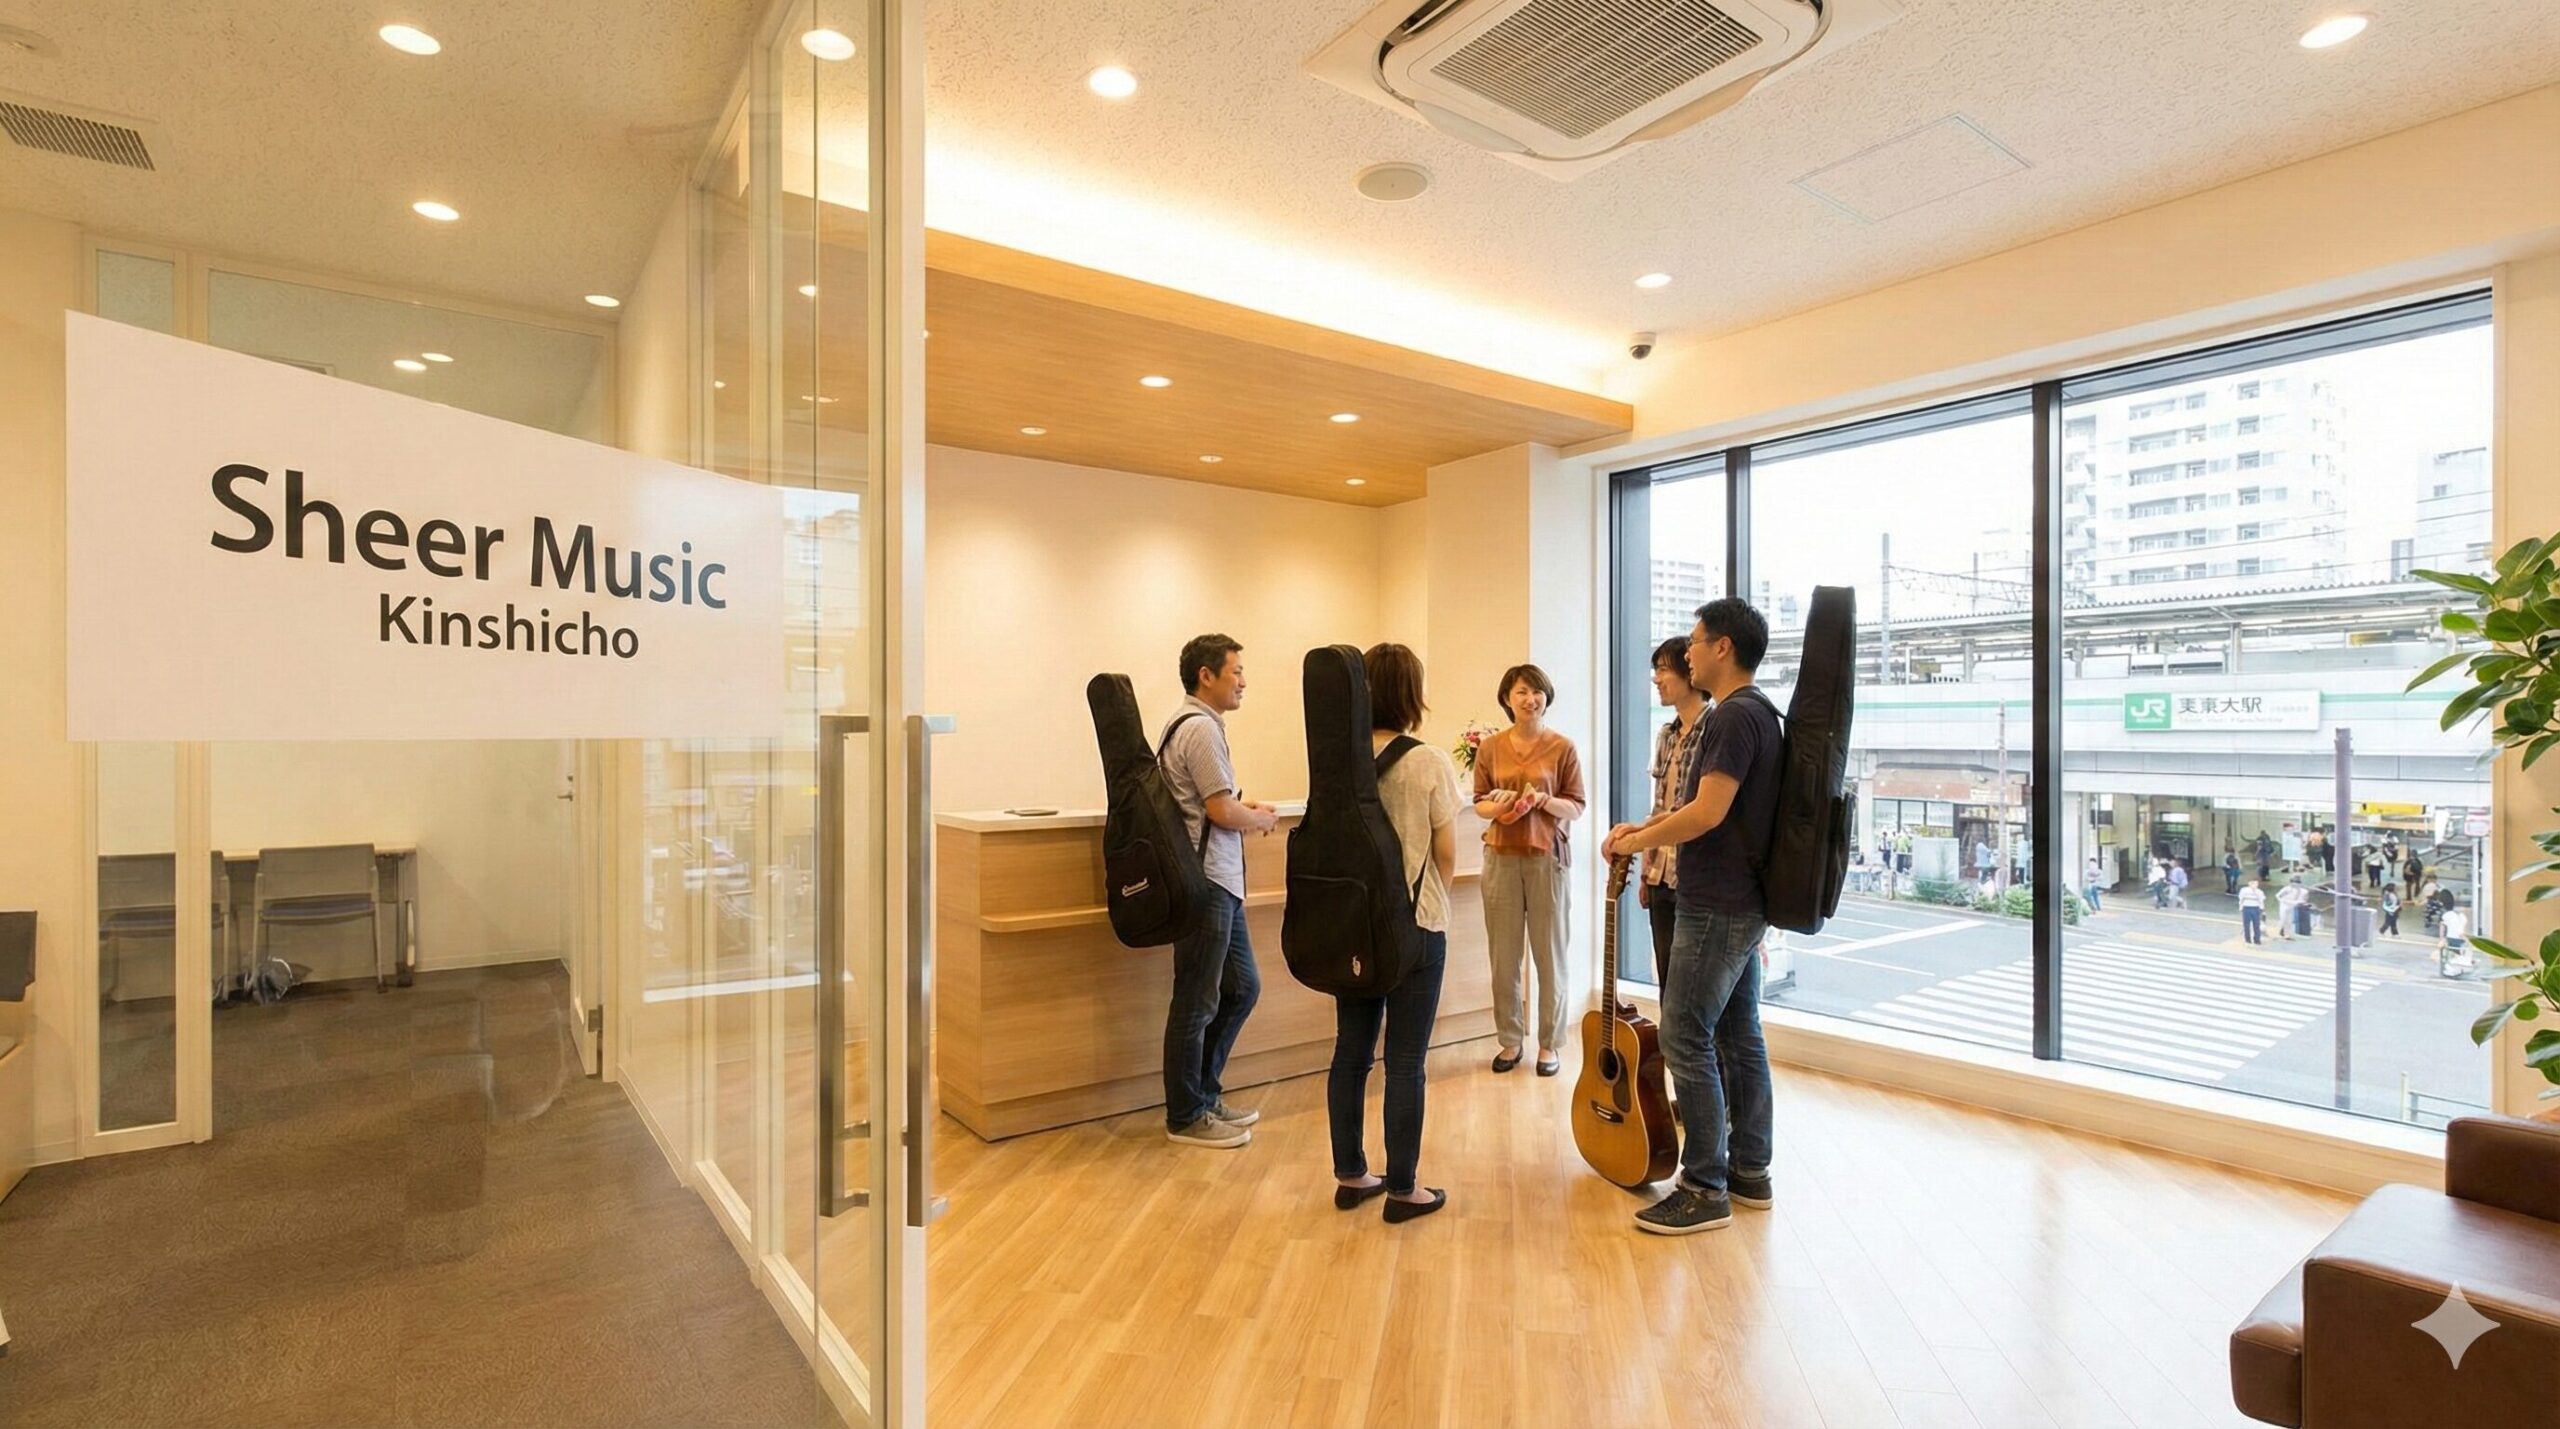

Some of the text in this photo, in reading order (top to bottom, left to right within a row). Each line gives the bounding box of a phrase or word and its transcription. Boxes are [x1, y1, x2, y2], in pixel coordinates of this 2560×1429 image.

[210, 463, 727, 610] Sheer Music
[379, 592, 640, 659] Kinshicho
[2131, 699, 2166, 718] JR
